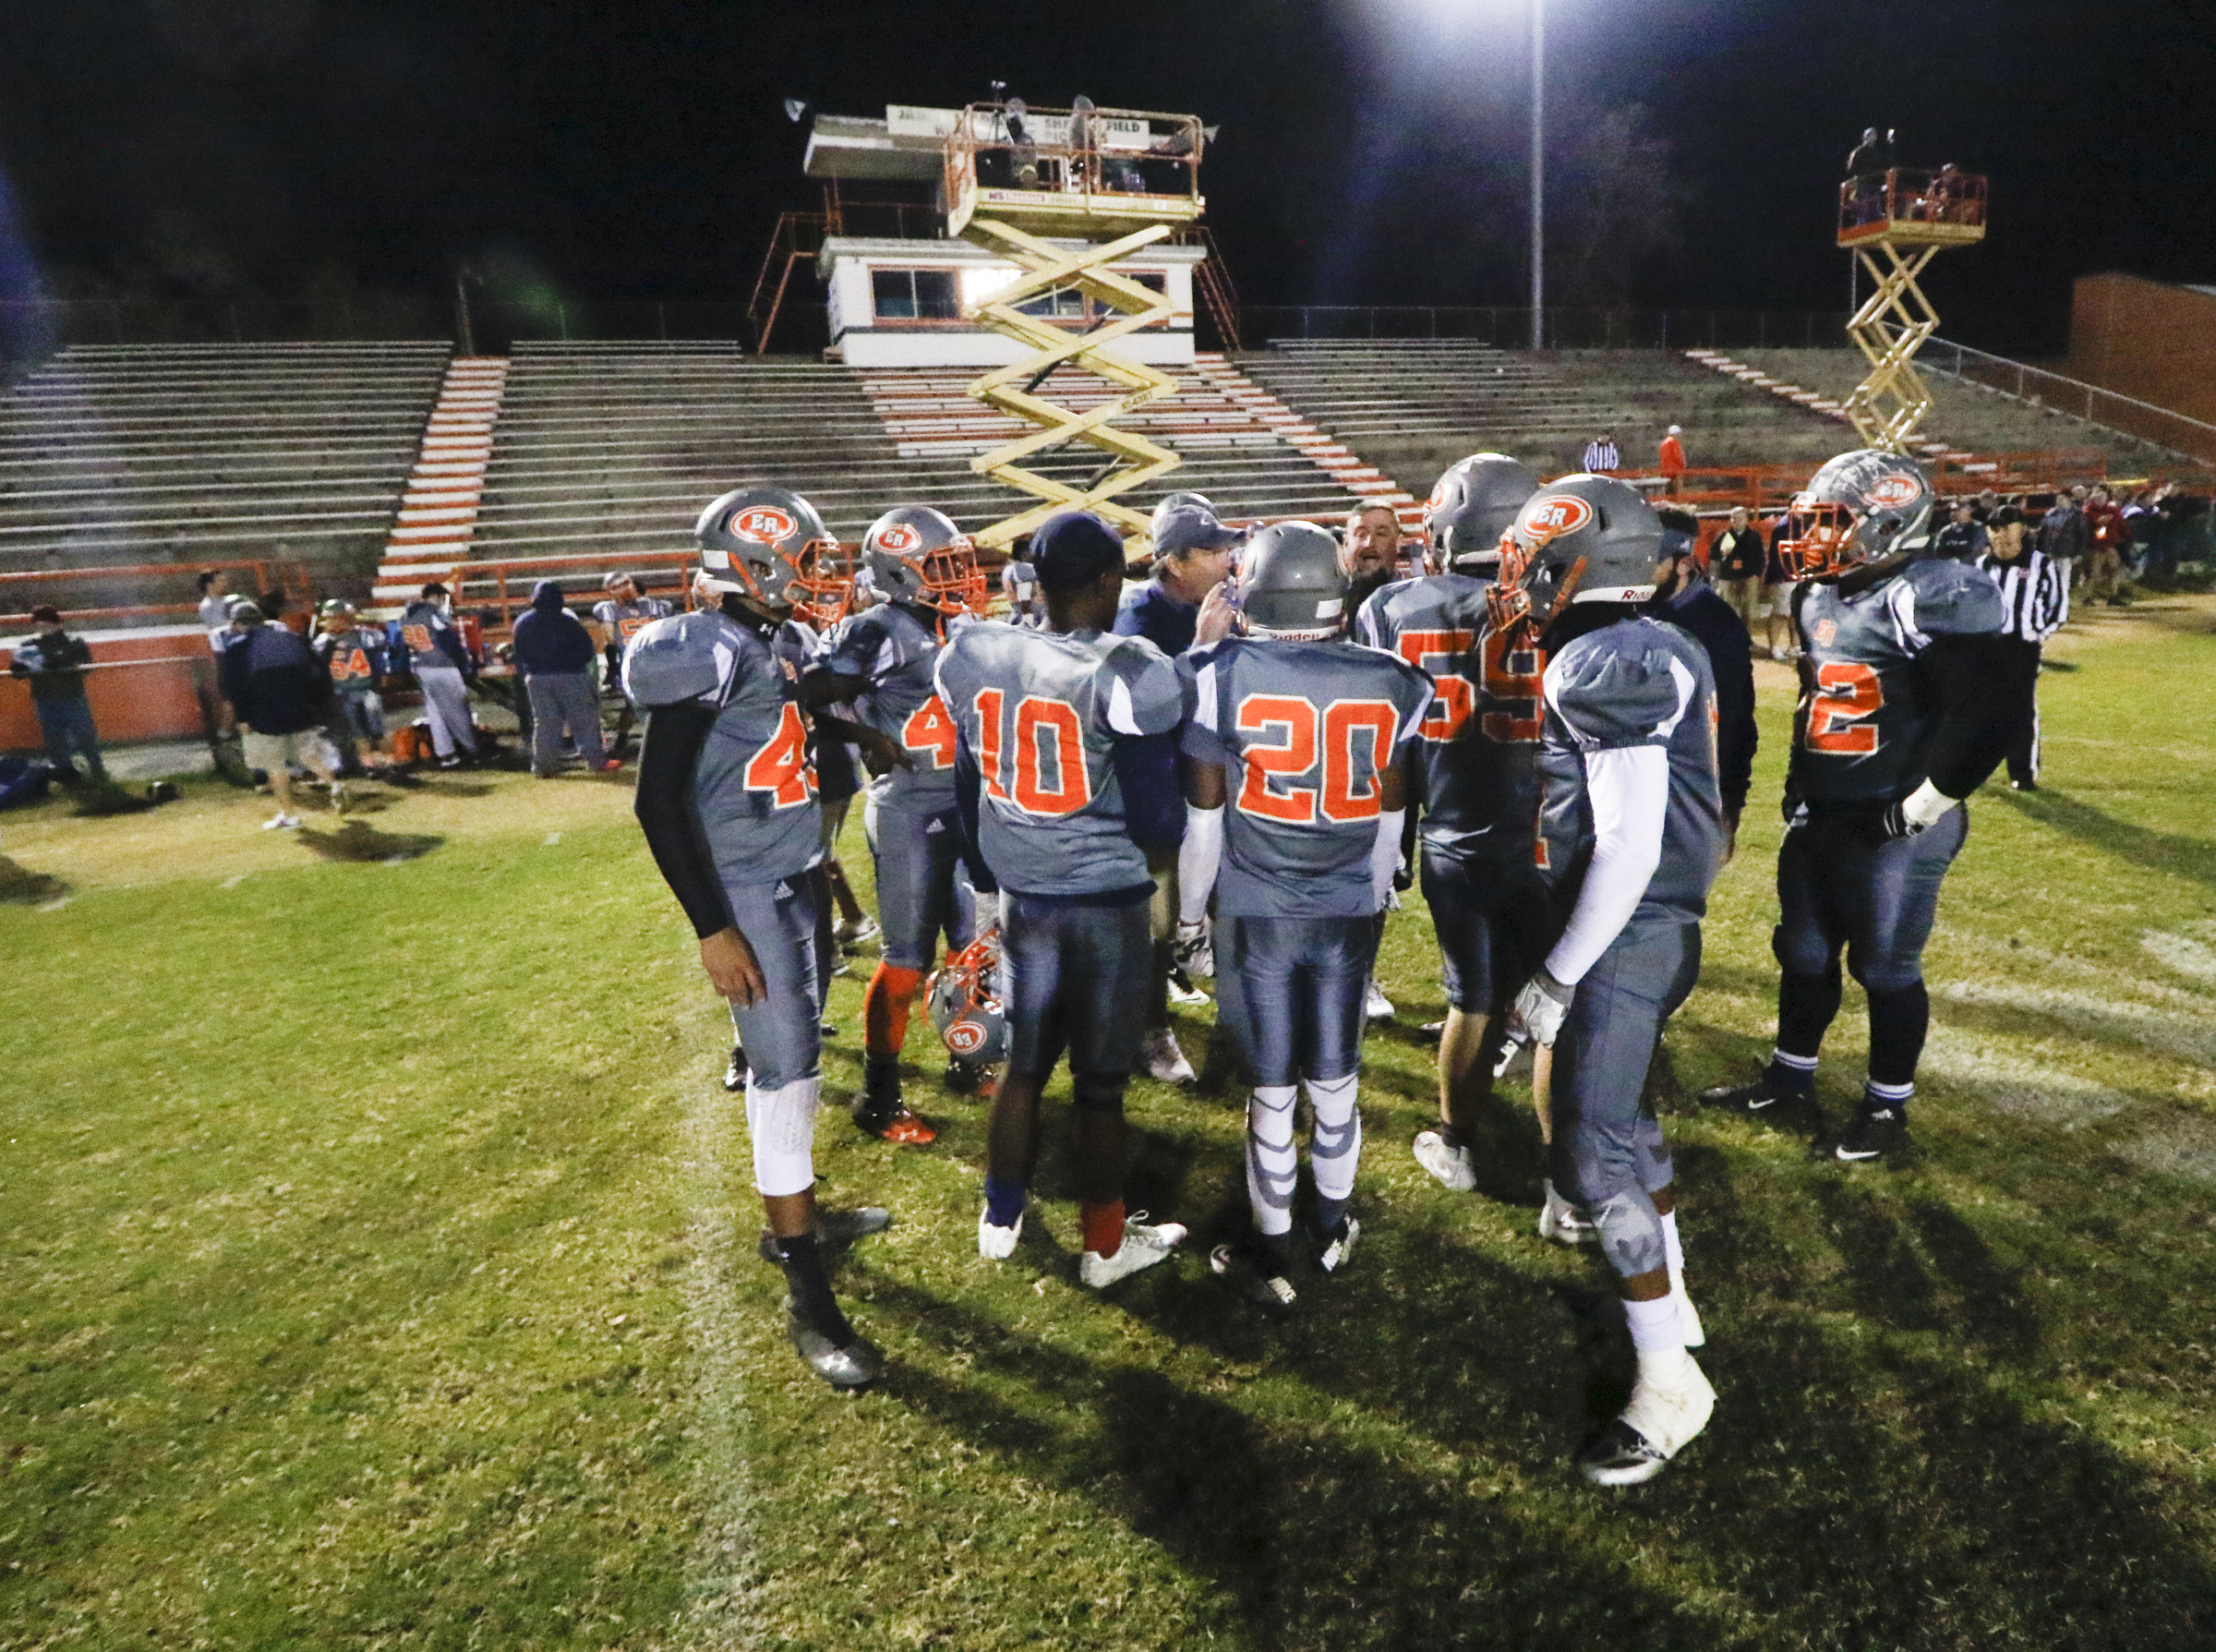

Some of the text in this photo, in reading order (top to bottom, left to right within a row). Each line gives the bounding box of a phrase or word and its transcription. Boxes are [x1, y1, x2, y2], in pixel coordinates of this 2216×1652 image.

[1106, 121, 1140, 132] FIELD
[749, 513, 777, 534] ER
[1536, 504, 1567, 526] ER
[885, 530, 905, 547] ER
[1398, 627, 1547, 743] 59
[1805, 660, 1885, 755] 2
[973, 686, 1092, 817] 10
[1235, 692, 1401, 825] 20
[953, 1032, 974, 1047] ER
